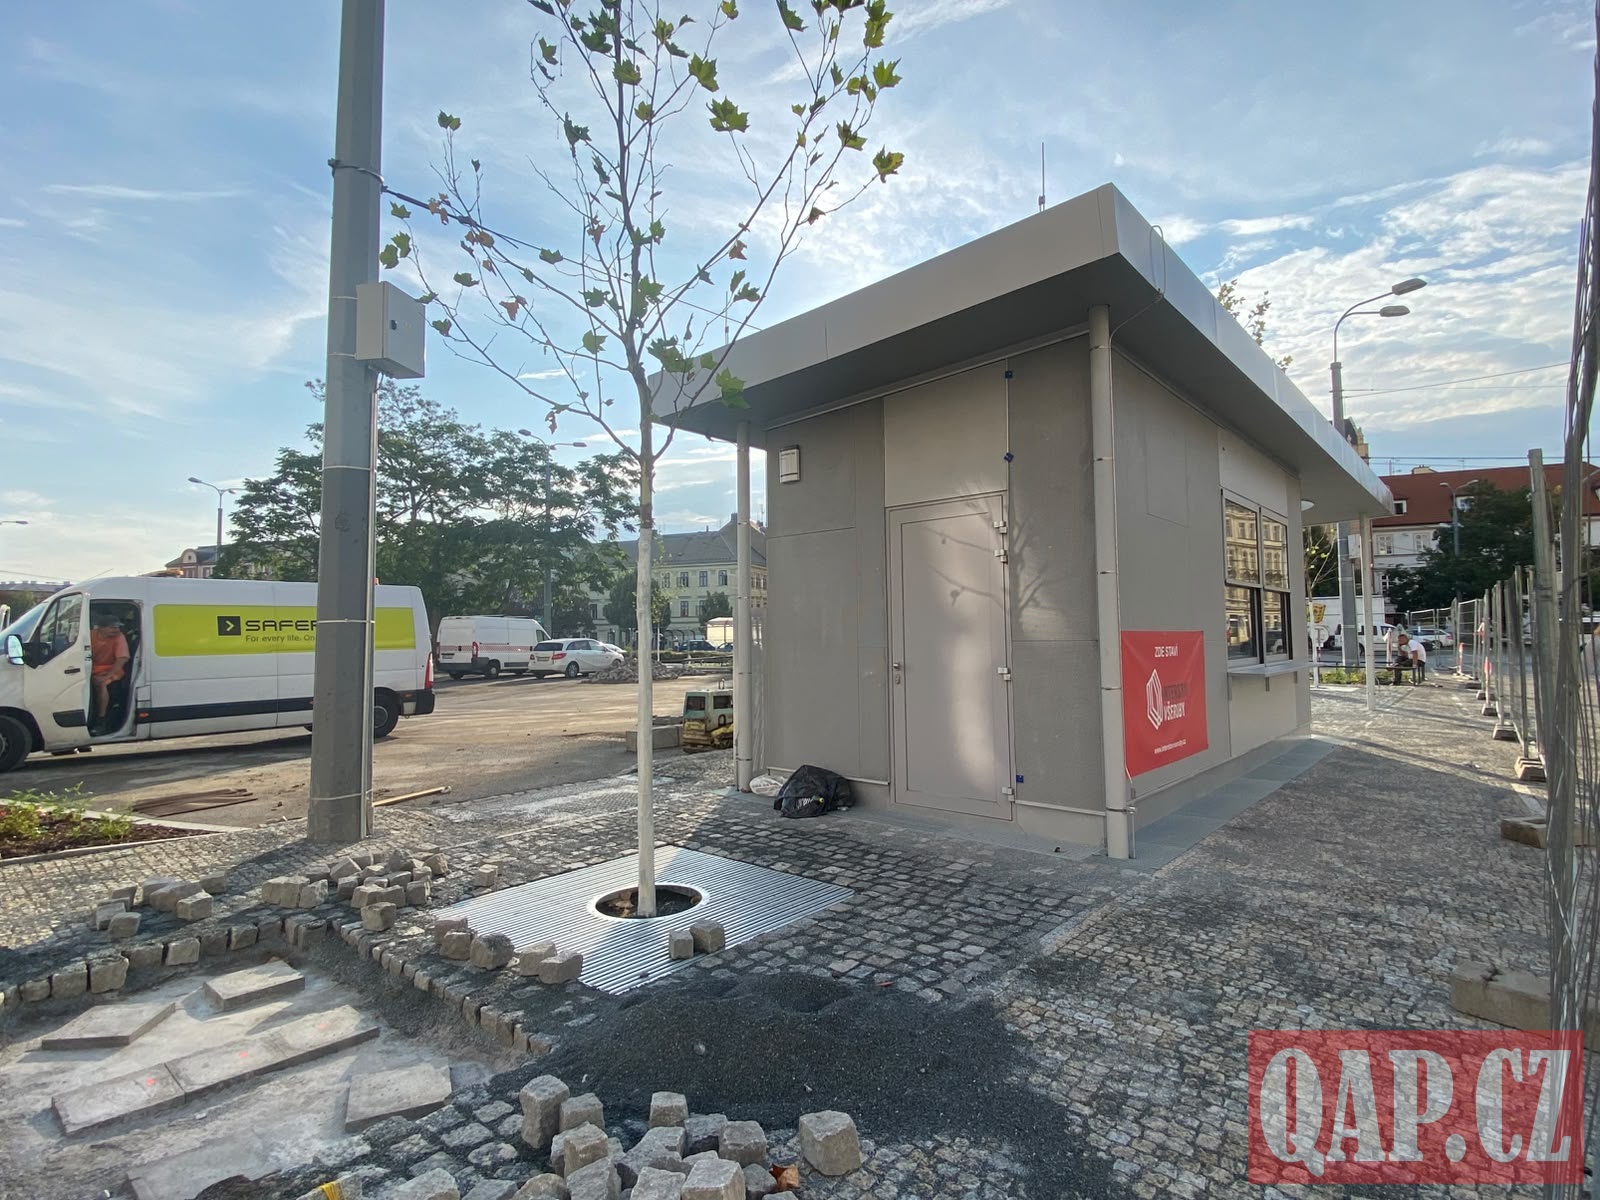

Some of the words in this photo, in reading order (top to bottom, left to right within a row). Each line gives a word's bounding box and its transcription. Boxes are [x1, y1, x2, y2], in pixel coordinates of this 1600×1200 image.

[245, 634, 259, 642] For
[261, 635, 285, 643] every
[287, 634, 302, 642] life.
[1154, 646, 1165, 658] ZDE
